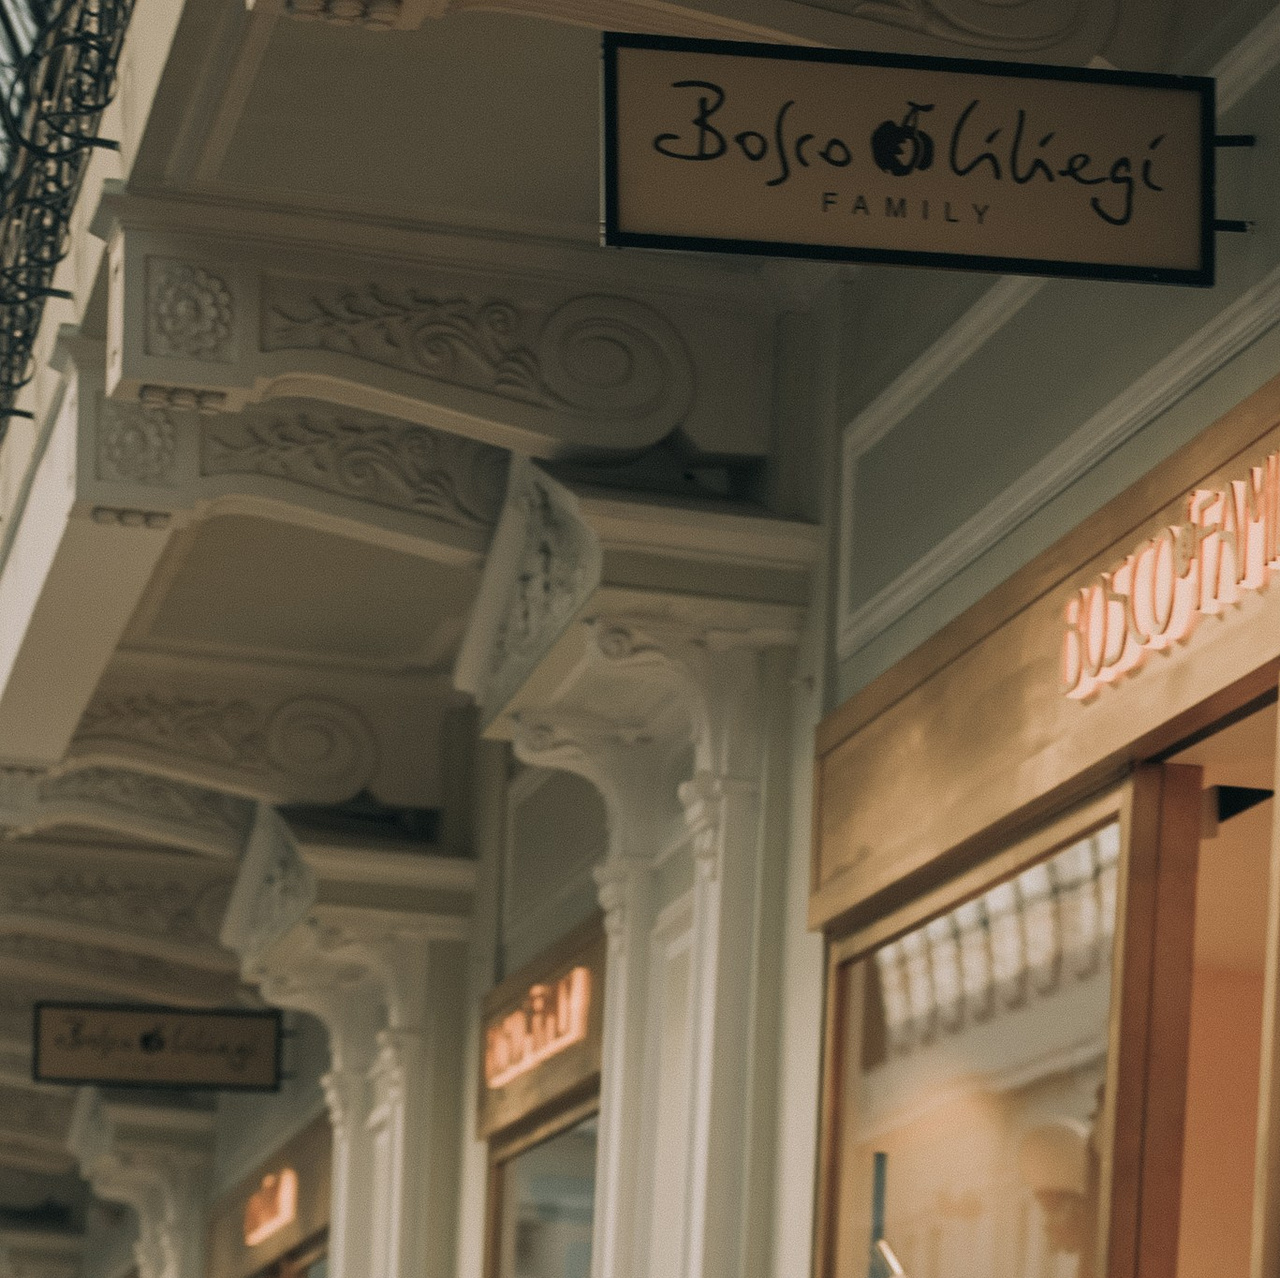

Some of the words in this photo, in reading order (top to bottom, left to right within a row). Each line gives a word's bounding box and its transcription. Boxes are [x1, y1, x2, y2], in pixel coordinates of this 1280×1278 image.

[654, 82, 851, 185] Bosco
[950, 101, 1165, 226] Ciliegi
[822, 192, 991, 225] FAMILY
